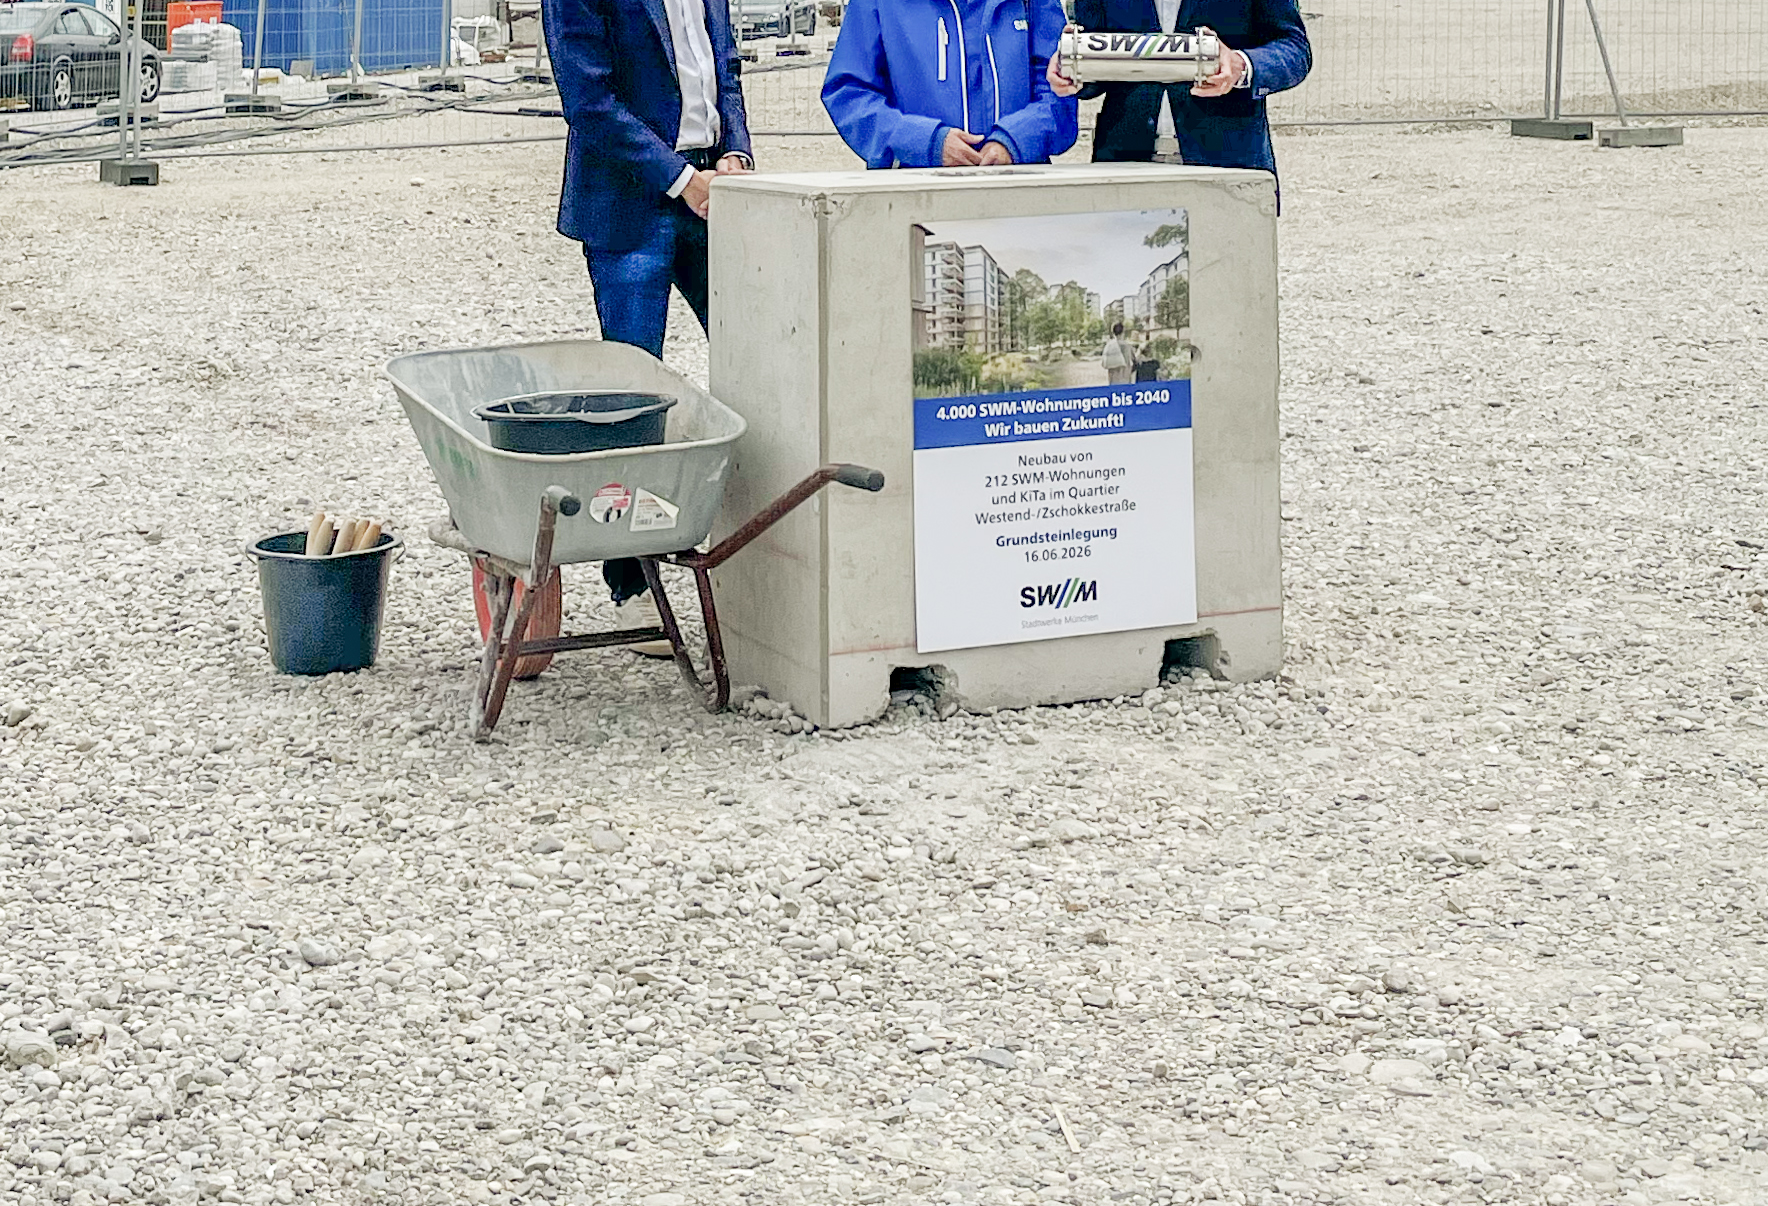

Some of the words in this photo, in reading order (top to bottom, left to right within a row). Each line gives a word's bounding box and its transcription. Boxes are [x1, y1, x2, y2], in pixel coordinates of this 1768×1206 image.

[936, 404, 977, 421] 4.000
[979, 395, 1109, 419] SWM-Wohnungen
[1112, 392, 1132, 406] bis
[1135, 389, 1170, 404] 2040
[985, 422, 1011, 437] Wir
[1013, 419, 1059, 436] bauen
[1062, 413, 1124, 432] Zukunft!
[1018, 452, 1067, 467] Neubau
[1070, 451, 1093, 463] von
[985, 474, 1008, 487] 212
[1011, 465, 1126, 486] SWM-Wohnungen
[991, 493, 1016, 505] und
[1020, 490, 1046, 502] KiTa
[1049, 488, 1065, 500] im
[1068, 484, 1120, 500] Quartier
[975, 499, 1137, 525] Westend-/Zschokkestraße
[996, 526, 1118, 548] Grundsteinlegung
[1024, 545, 1092, 563] 16.06.2026
[1021, 617, 1062, 629] Stadtwerke
[1064, 614, 1099, 625] München
